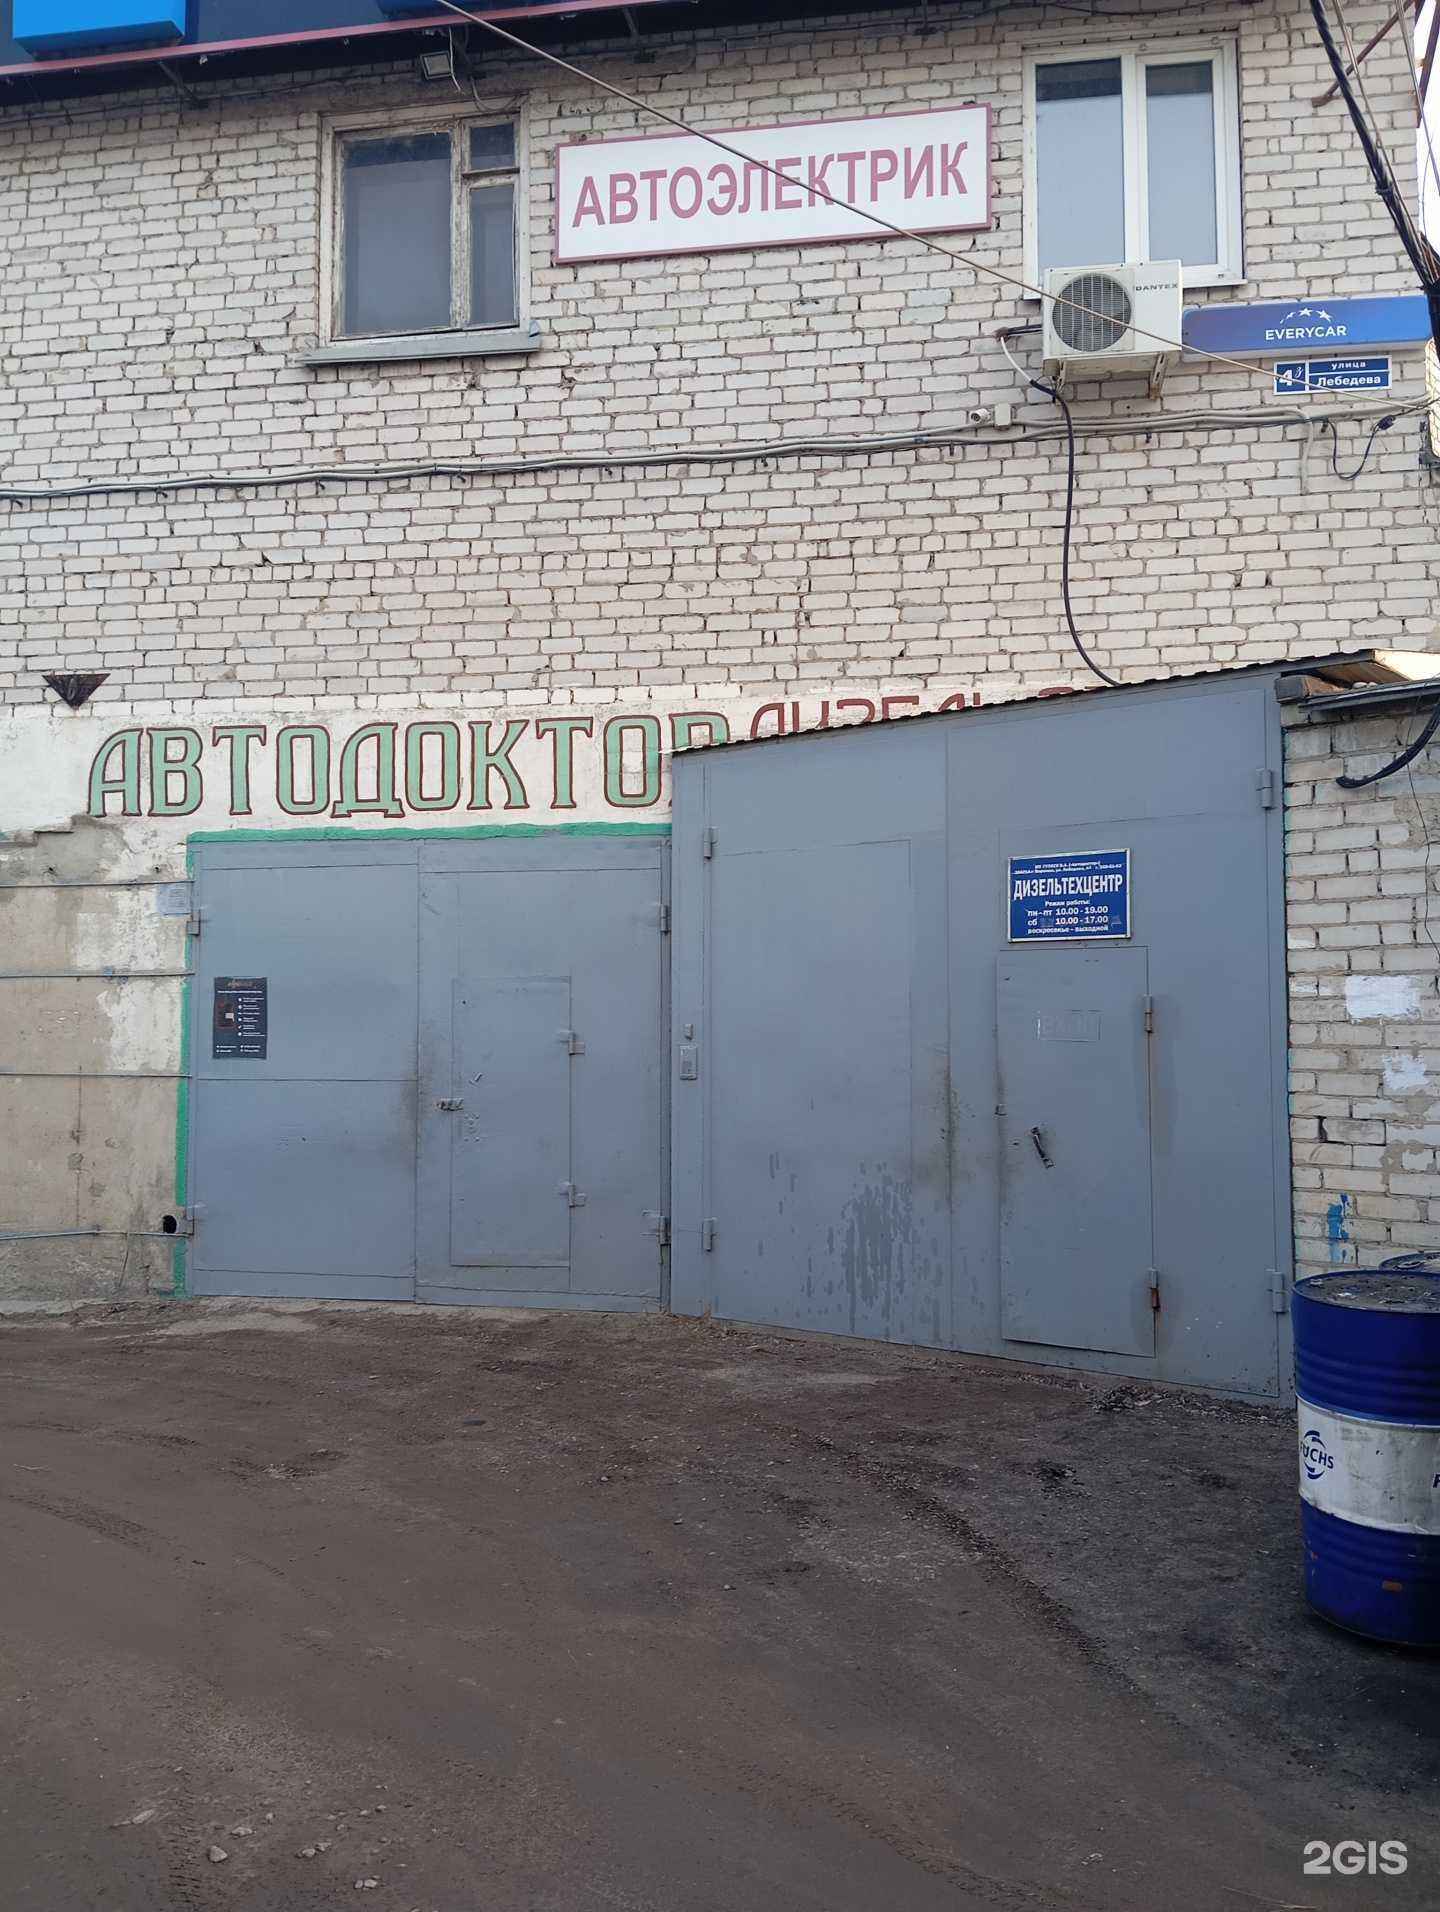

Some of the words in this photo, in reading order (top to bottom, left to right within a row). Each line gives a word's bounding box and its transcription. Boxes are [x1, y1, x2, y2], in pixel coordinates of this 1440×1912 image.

[572, 141, 968, 228] АВТОЭЛЕКТРИК
[1135, 283, 1178, 291] DANTEX
[1265, 325, 1347, 341] EVERYCAR
[1331, 360, 1366, 370] улица
[1317, 375, 1381, 387] Лебедева
[1013, 874, 1123, 900] ДИЗЕЛЬТЕХЦЕНТР
[1055, 907, 1079, 916] 10.00
[1084, 905, 1109, 914] 19.00
[1027, 918, 1038, 926] сб
[1055, 916, 1079, 925] 10.00
[1084, 915, 1109, 924] 17.00
